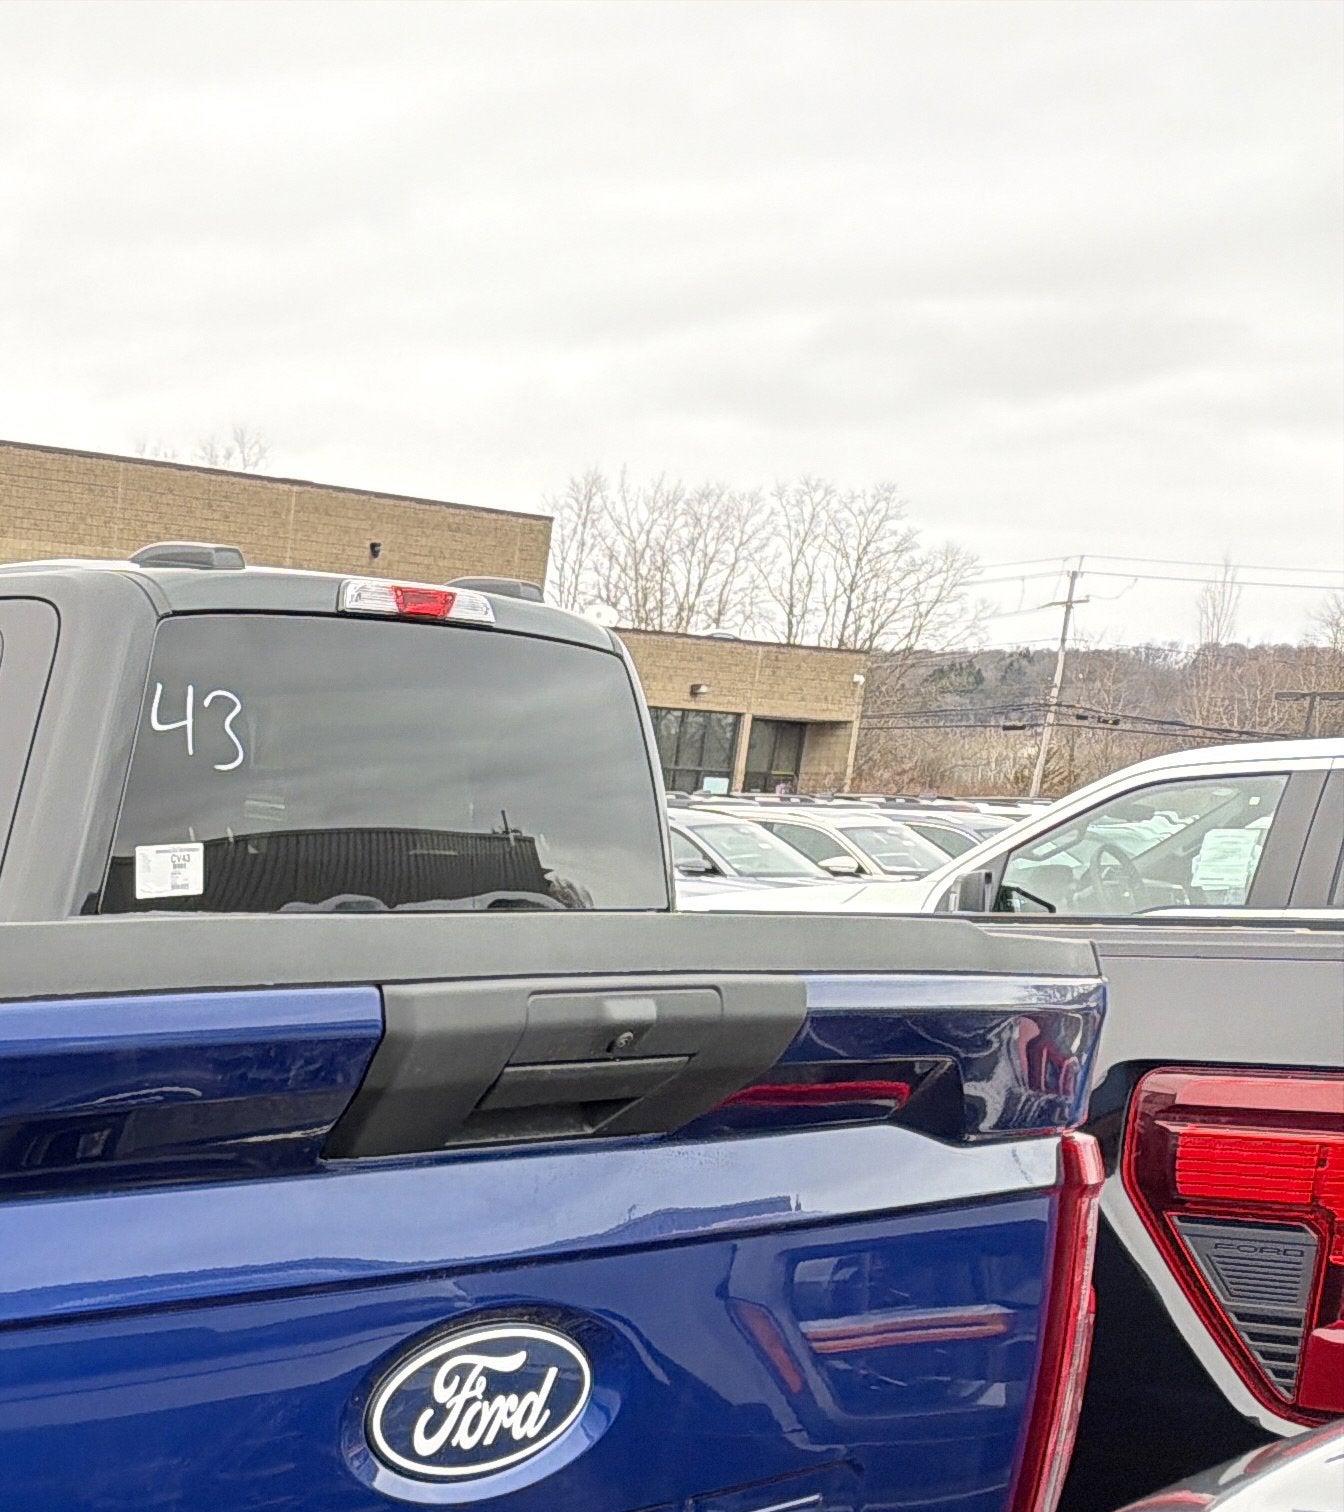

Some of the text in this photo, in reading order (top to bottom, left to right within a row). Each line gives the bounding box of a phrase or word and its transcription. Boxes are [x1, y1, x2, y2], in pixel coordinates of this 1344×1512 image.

[150, 682, 244, 771] 43
[1213, 1242, 1305, 1258] FORD
[413, 1350, 559, 1457] Ford
